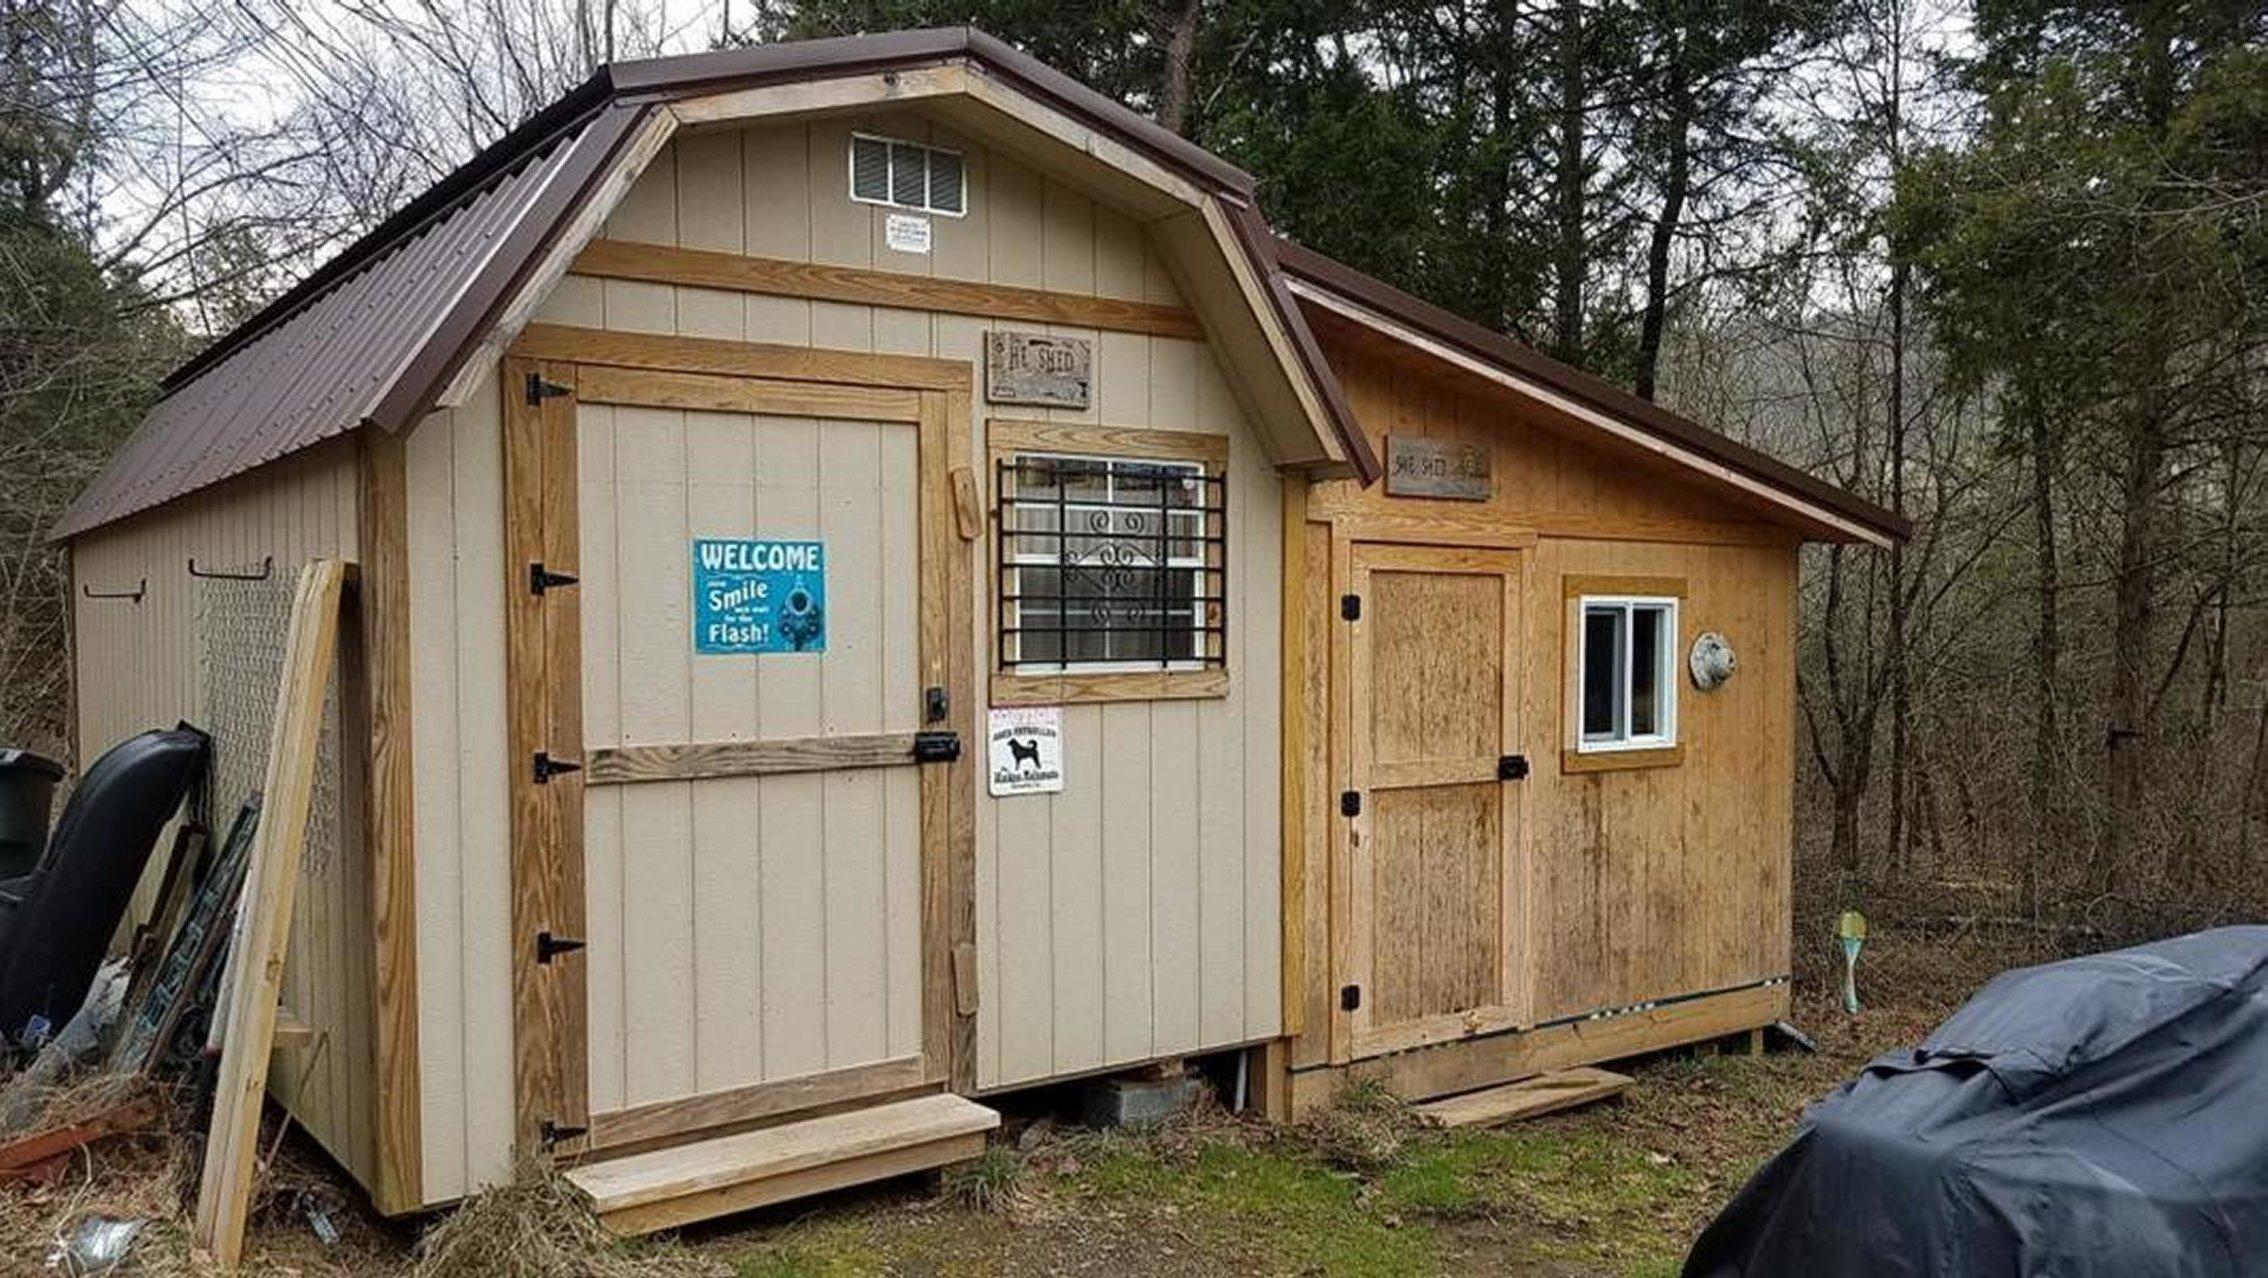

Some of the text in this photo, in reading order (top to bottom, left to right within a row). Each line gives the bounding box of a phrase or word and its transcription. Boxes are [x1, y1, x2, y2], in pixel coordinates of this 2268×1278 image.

[700, 543, 820, 571] WELCOME
[708, 579, 768, 612] Smile
[709, 623, 769, 643] Flash!
